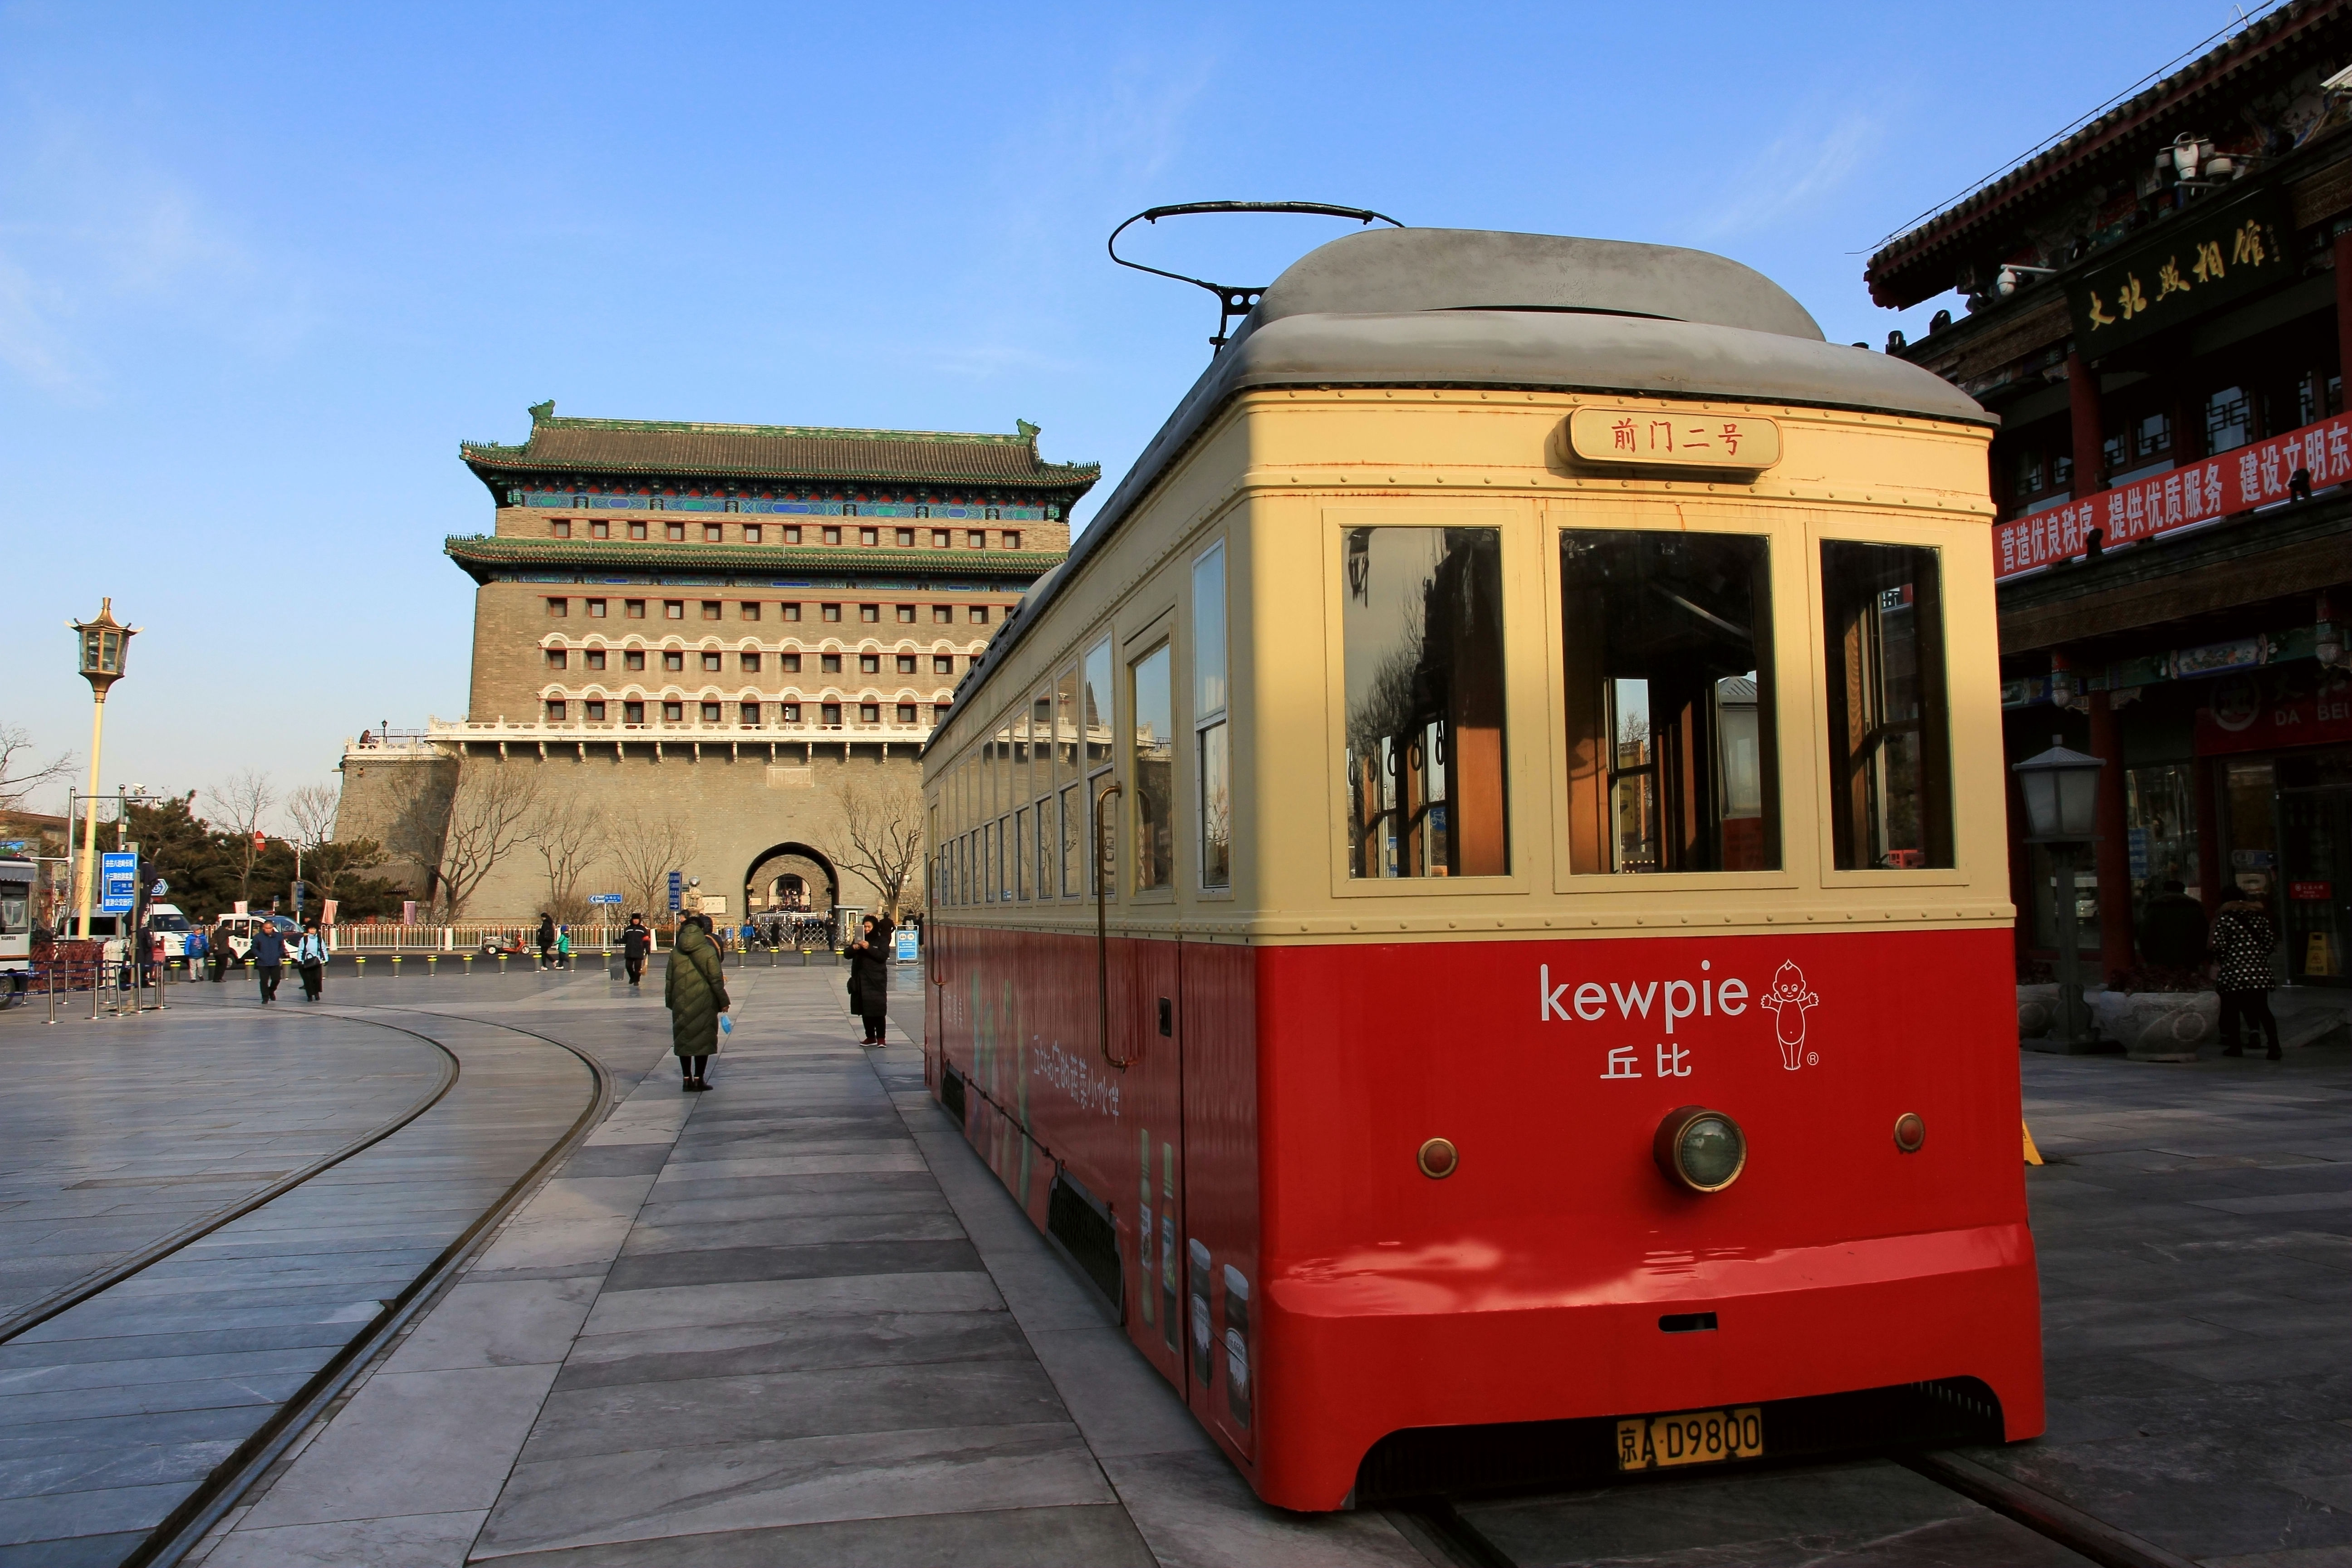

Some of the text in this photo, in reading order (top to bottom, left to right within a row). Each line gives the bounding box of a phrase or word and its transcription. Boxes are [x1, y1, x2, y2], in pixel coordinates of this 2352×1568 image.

[1611, 417, 1743, 456] 前门二号
[2001, 501, 2095, 572] 营造优良秩序
[2108, 463, 2223, 541] 提供优质服务
[2274, 702, 2351, 726] DA BEI
[1540, 960, 1749, 1034] kewpie
[1600, 1043, 1692, 1079] 丘比
